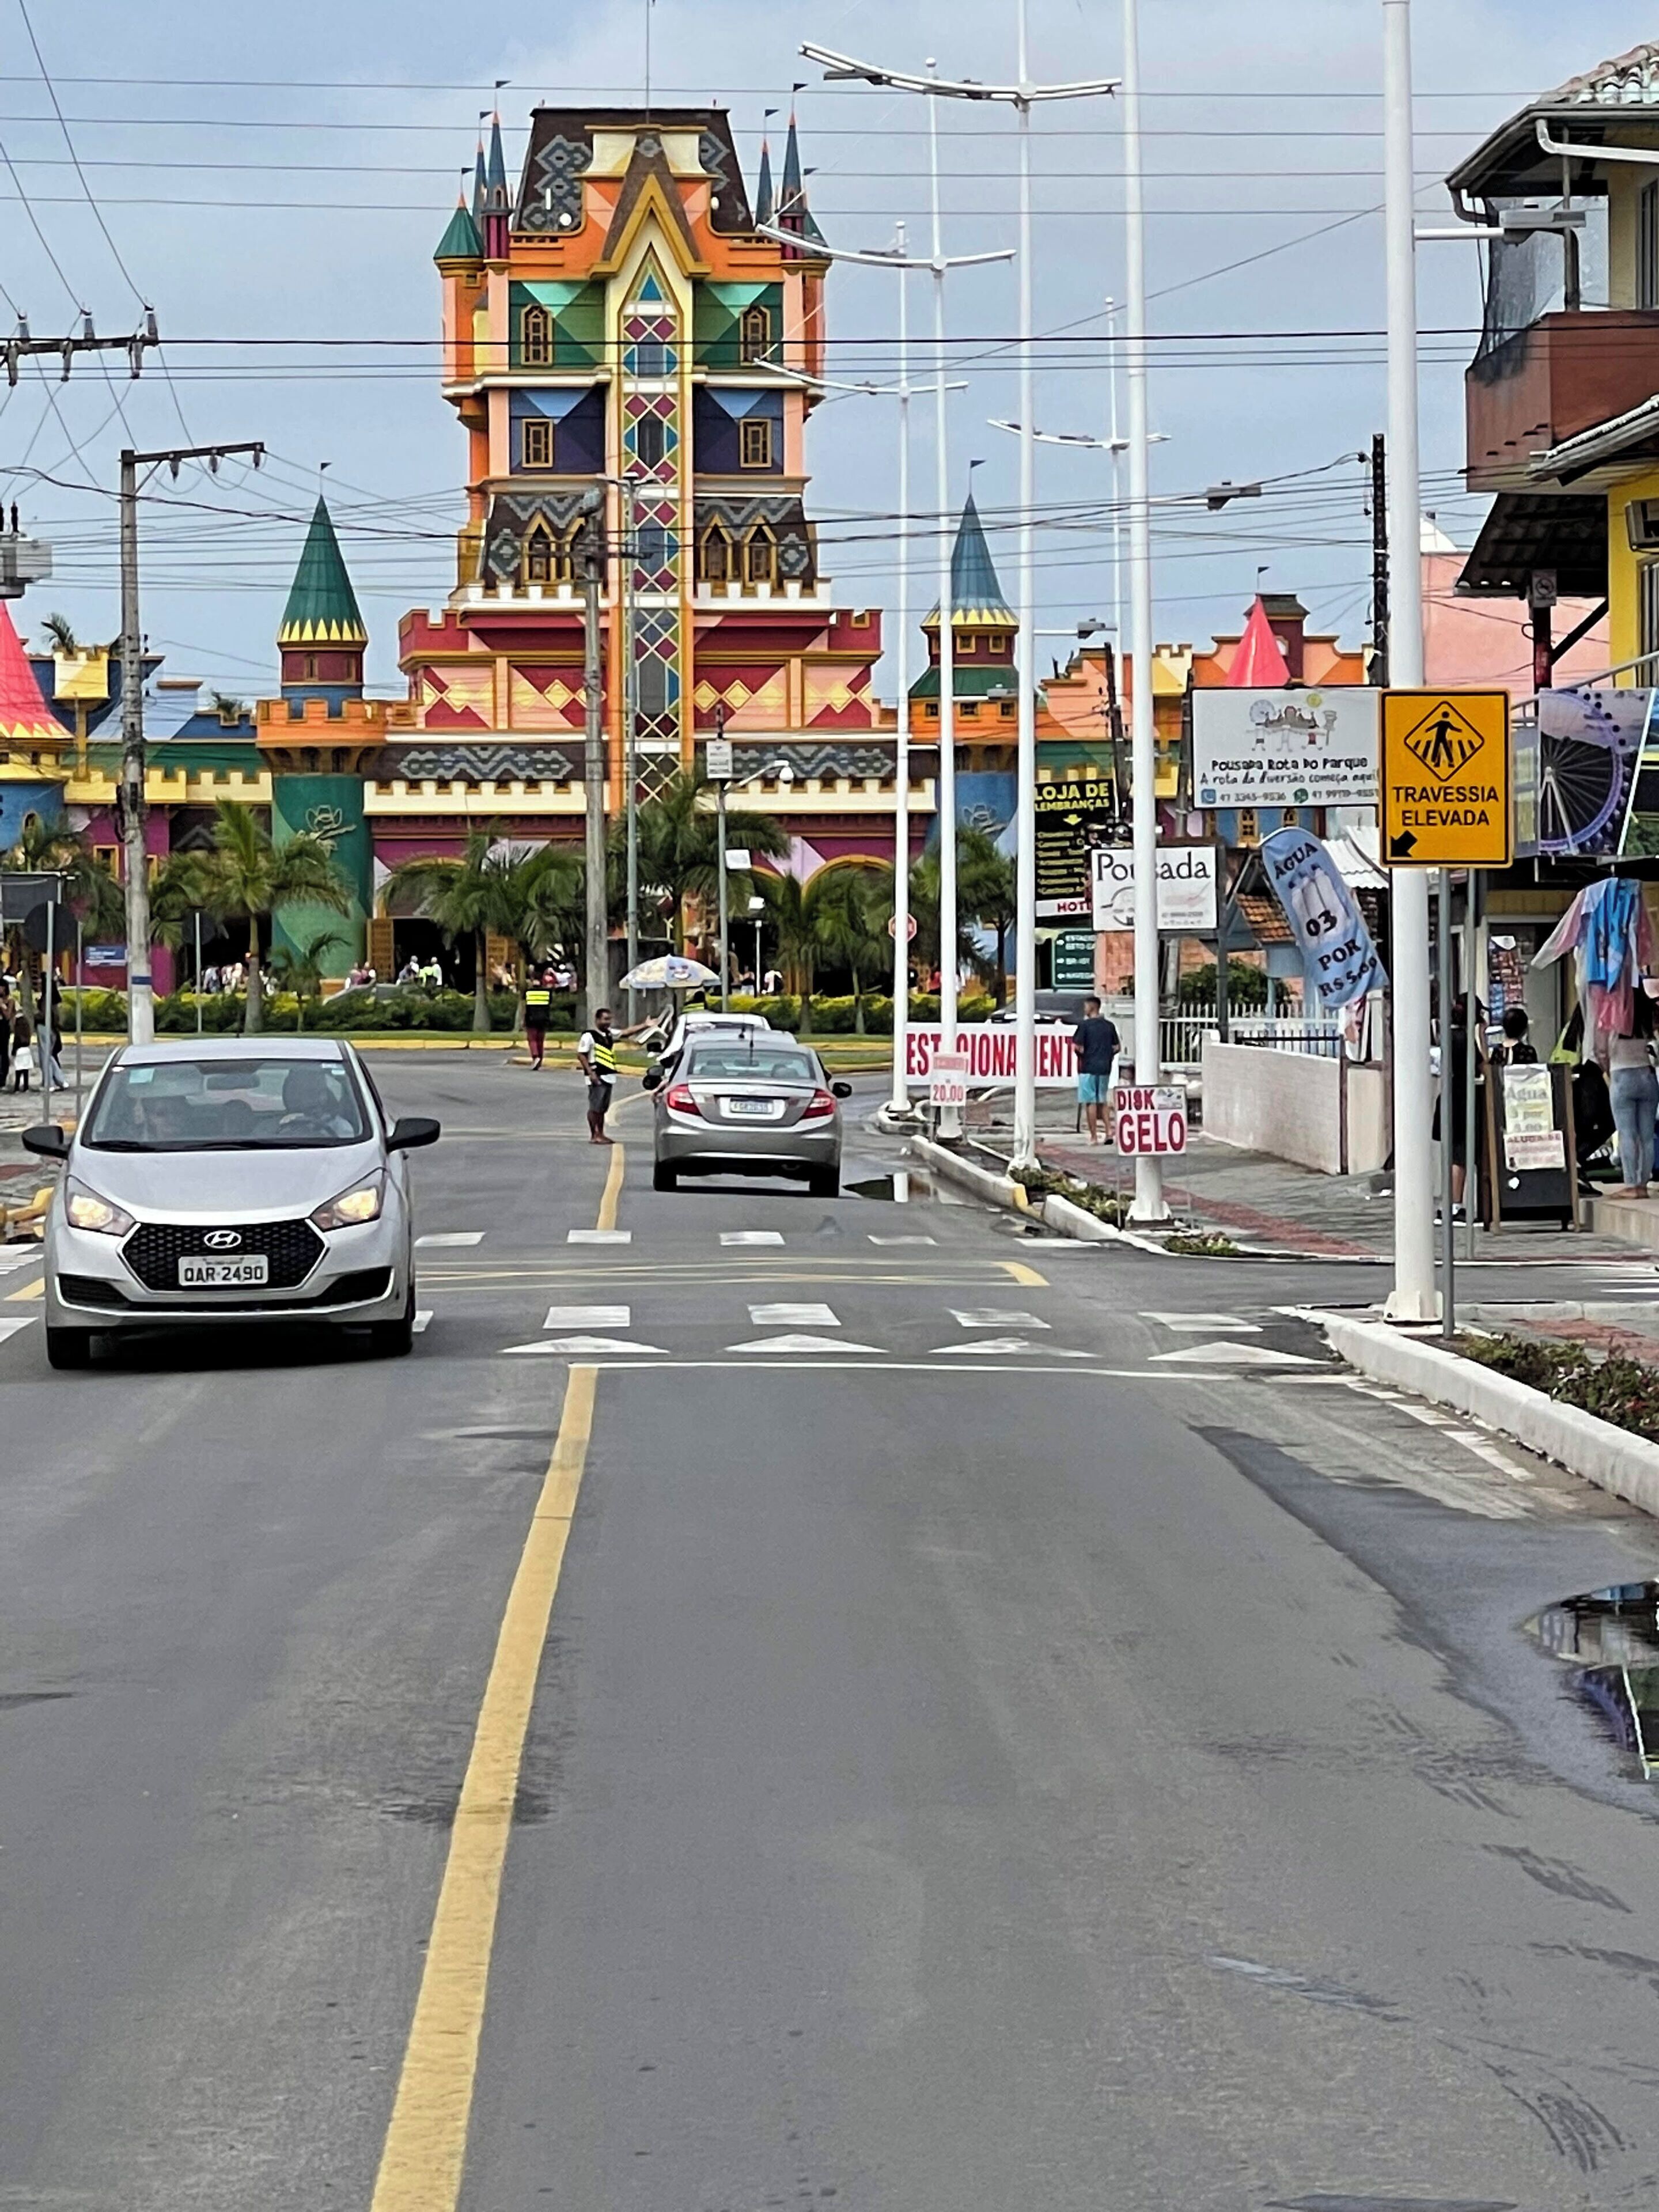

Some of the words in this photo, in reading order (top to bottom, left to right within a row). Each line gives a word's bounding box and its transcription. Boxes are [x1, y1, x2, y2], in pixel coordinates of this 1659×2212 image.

[1268, 759, 1298, 770] Rota
[1323, 757, 1368, 770] Parque
[1200, 772, 1209, 785] A
[1213, 773, 1238, 785] rota
[1035, 783, 1081, 801] LOJA
[1086, 782, 1109, 797] DE
[1392, 786, 1499, 802] TRAVESSIA
[1035, 798, 1109, 812] LEMBRANÇAS
[1402, 809, 1490, 826] ELEVADA
[1097, 851, 1211, 881] Poada
[1305, 909, 1338, 937] 03
[1318, 938, 1361, 971] POR
[1118, 1089, 1155, 1111] DISK
[1119, 1112, 1185, 1154] GELO
